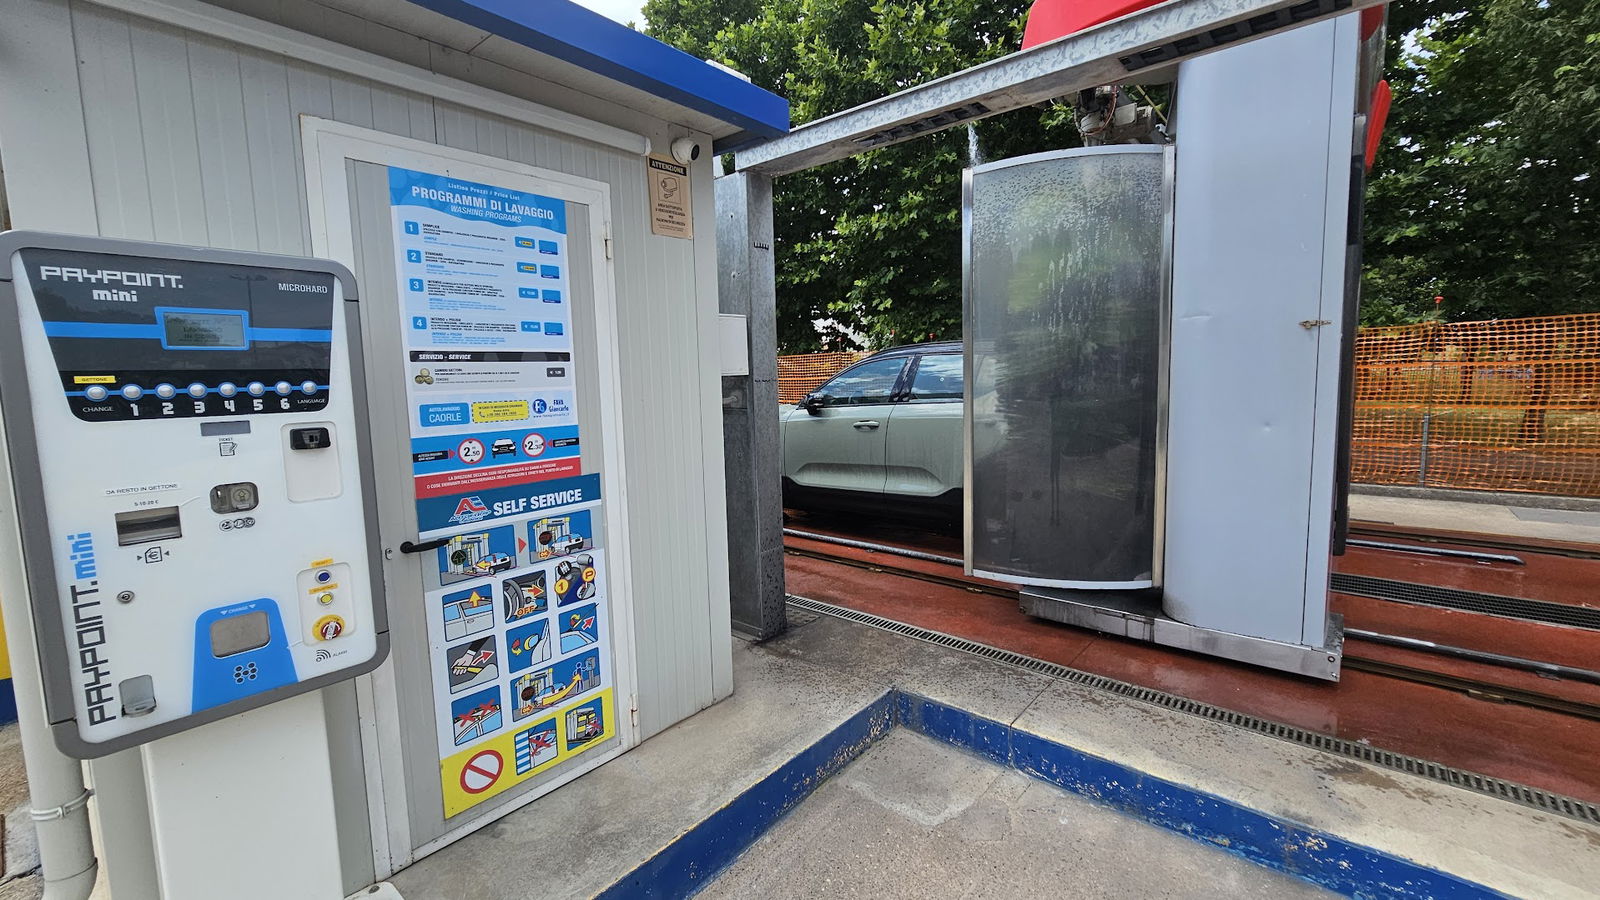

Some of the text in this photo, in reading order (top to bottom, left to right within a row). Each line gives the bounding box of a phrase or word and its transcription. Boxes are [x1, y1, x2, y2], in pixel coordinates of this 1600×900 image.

[651, 160, 685, 175] ATTENZIONE
[448, 183, 469, 192] Listino
[470, 186, 488, 196] Prezzi
[494, 190, 508, 199] Price
[411, 185, 554, 220] PROGRAMMI DI LAVAGGIO
[450, 205, 522, 223] WASHING PROGRAMS
[408, 224, 414, 232] 1
[410, 252, 417, 260] 2
[278, 282, 328, 294] MICROHARD
[413, 281, 420, 289] 3
[92, 288, 138, 303] mini
[416, 319, 422, 327] 4
[130, 403, 139, 416] 1
[162, 402, 175, 415] 2
[194, 401, 206, 414] 3
[224, 400, 236, 412] 4
[253, 399, 264, 411] 5
[280, 398, 290, 410] 6
[548, 405, 569, 413] Giancarlo
[428, 412, 462, 423] CAORLE
[148, 483, 178, 491] GETTONE
[493, 488, 582, 516] SELF SERVICE
[67, 532, 97, 580] mini
[228, 605, 249, 614] CHANGE
[516, 604, 535, 616] OFF
[332, 649, 348, 658] ALARM
